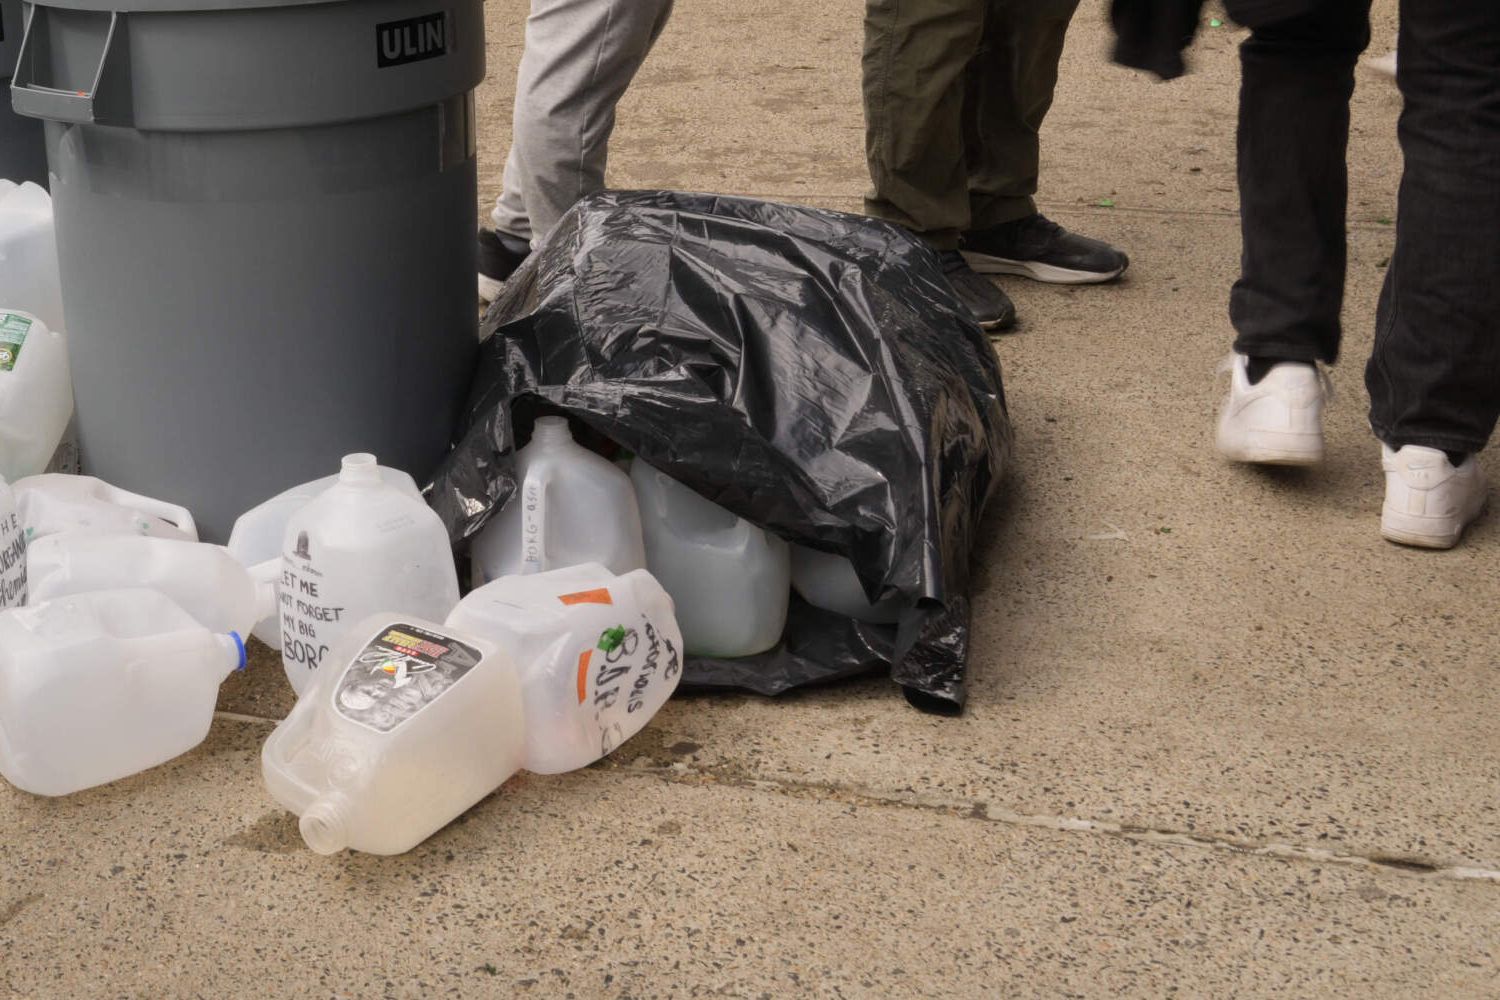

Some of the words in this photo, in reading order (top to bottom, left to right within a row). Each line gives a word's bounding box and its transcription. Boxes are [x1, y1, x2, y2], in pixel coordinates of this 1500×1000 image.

[299, 579, 319, 598] ME
[296, 599, 345, 622] FORGET
[283, 612, 296, 632] MY
[298, 620, 316, 639] BIG
